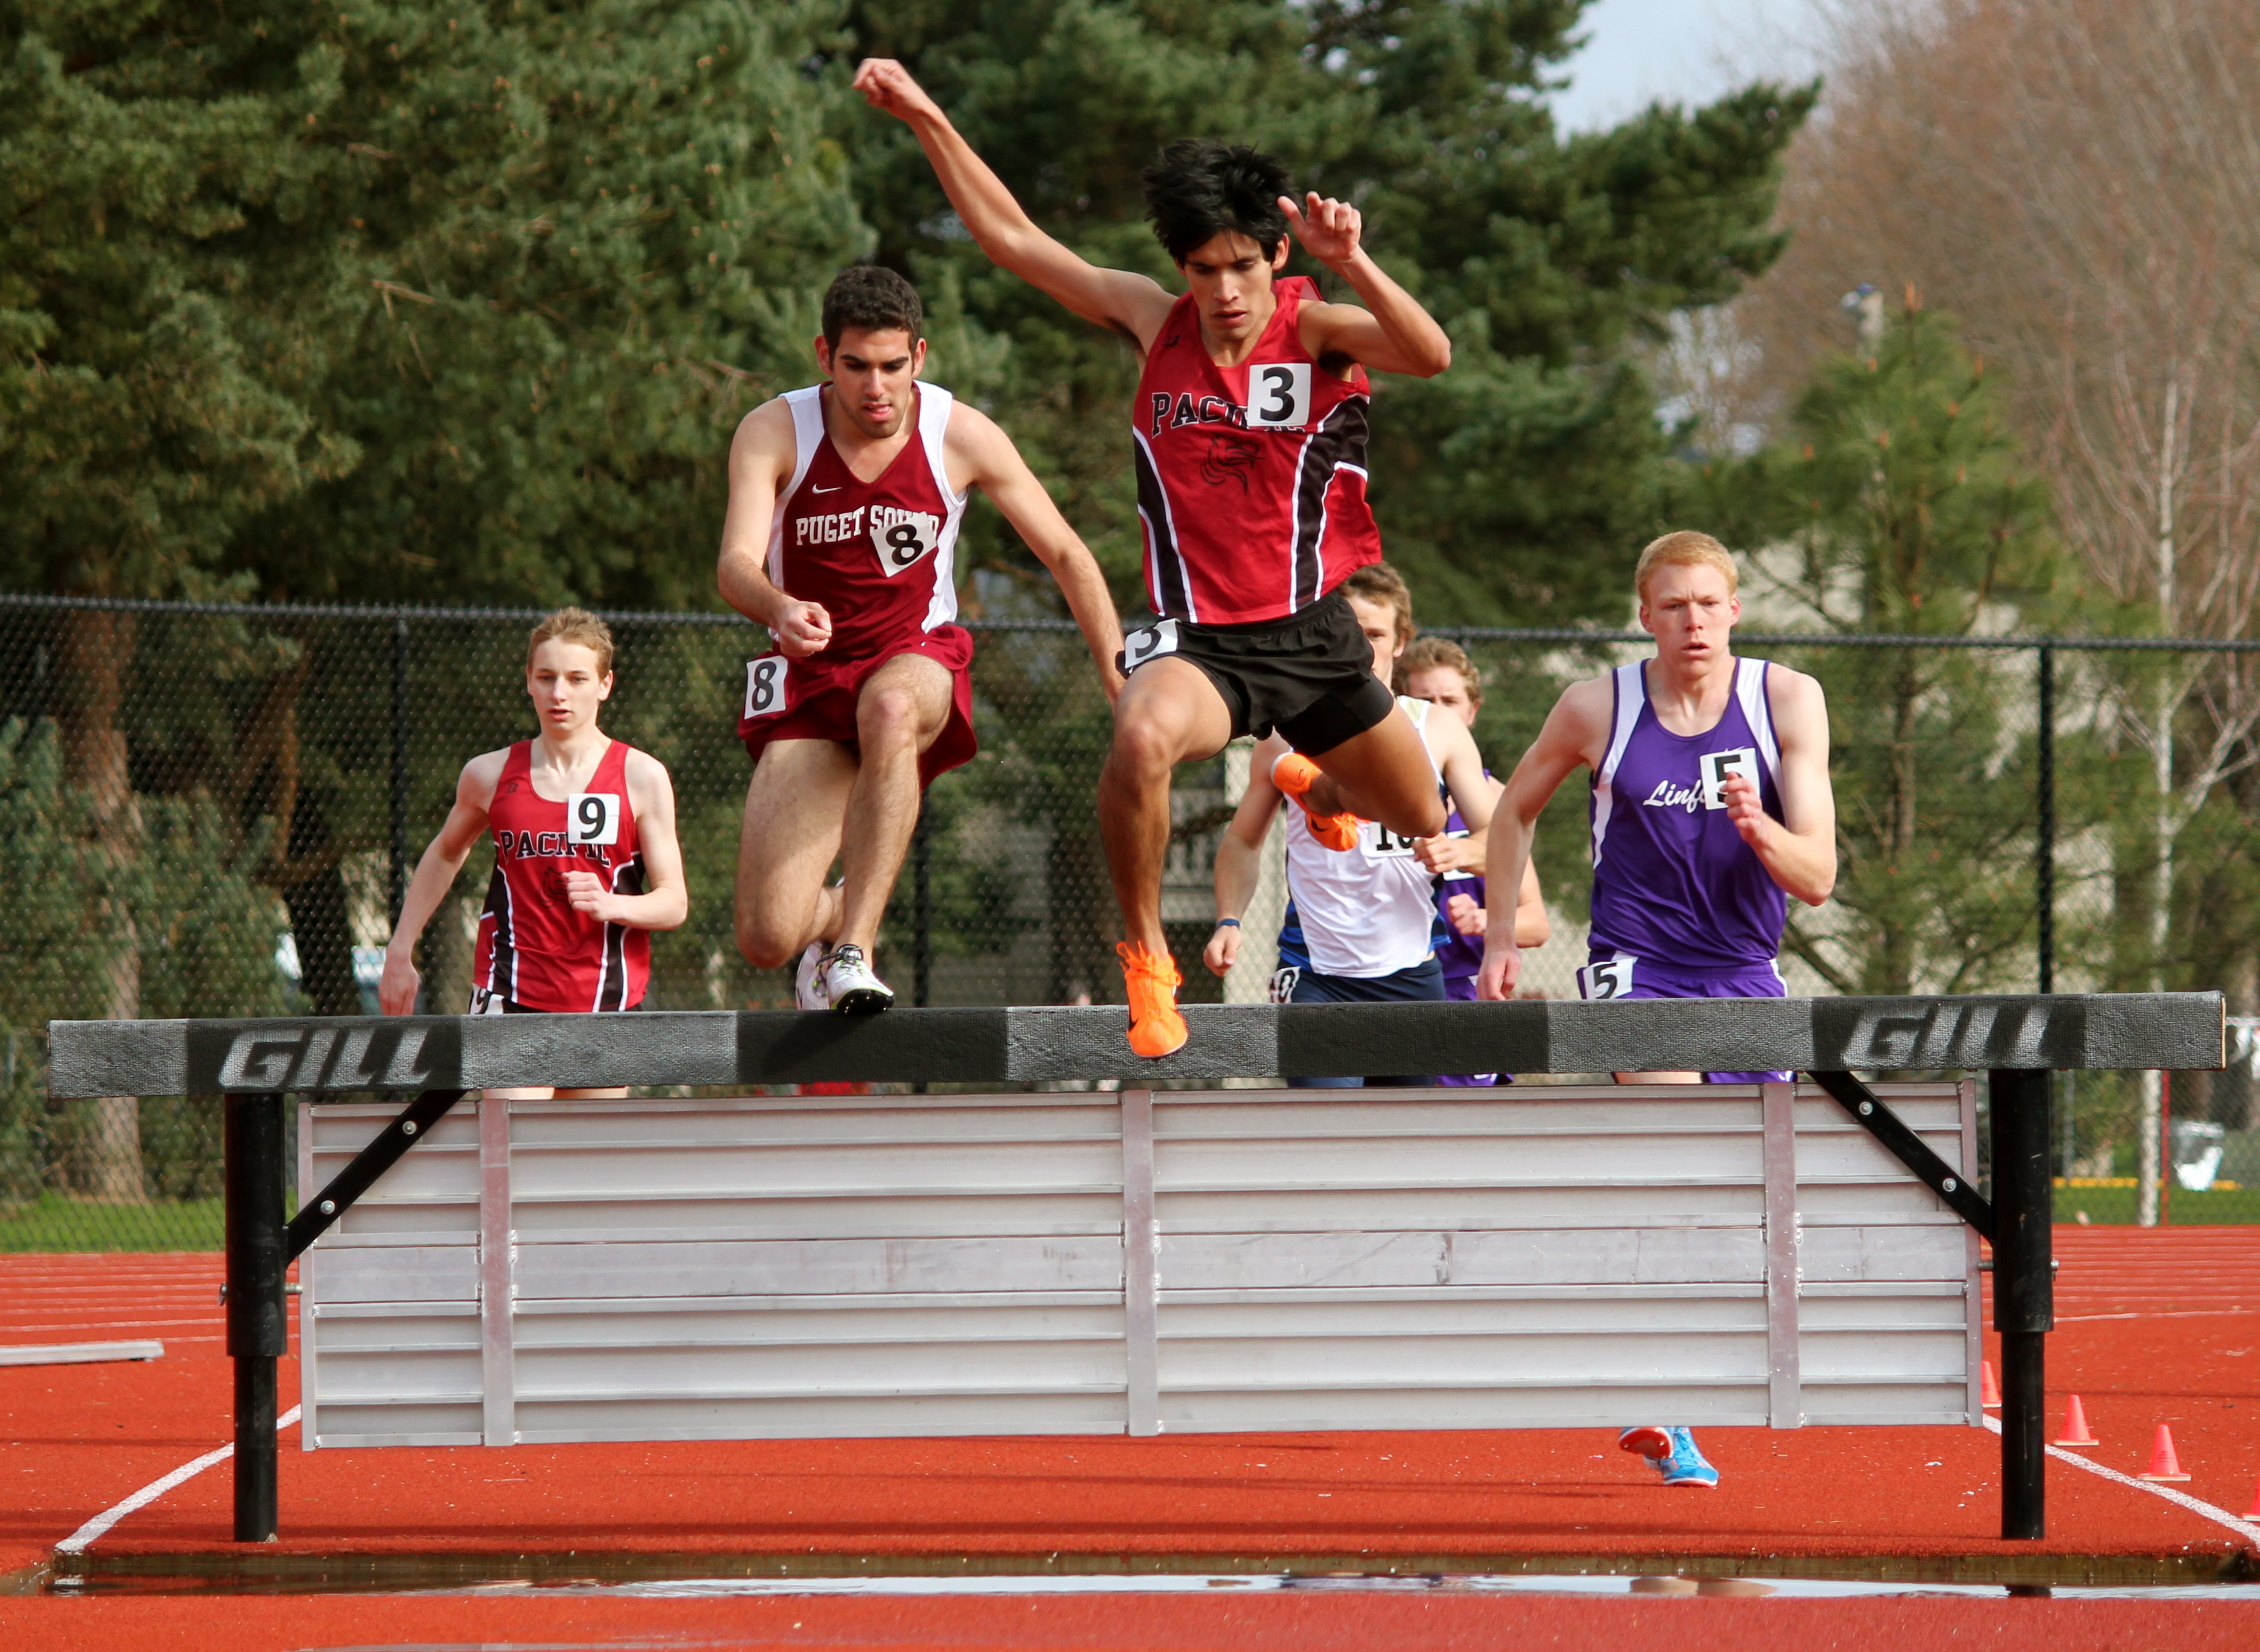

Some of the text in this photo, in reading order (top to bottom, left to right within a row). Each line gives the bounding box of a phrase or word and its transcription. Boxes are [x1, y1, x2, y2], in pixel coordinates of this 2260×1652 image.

[1259, 366, 1295, 422] 3
[796, 505, 866, 546] PUGET
[886, 523, 924, 566] 8
[751, 660, 777, 711] 8
[578, 797, 606, 840] 9
[1594, 962, 1618, 1000] 5
[219, 1028, 432, 1088] GILL
[1840, 1005, 2055, 1069] GILL
